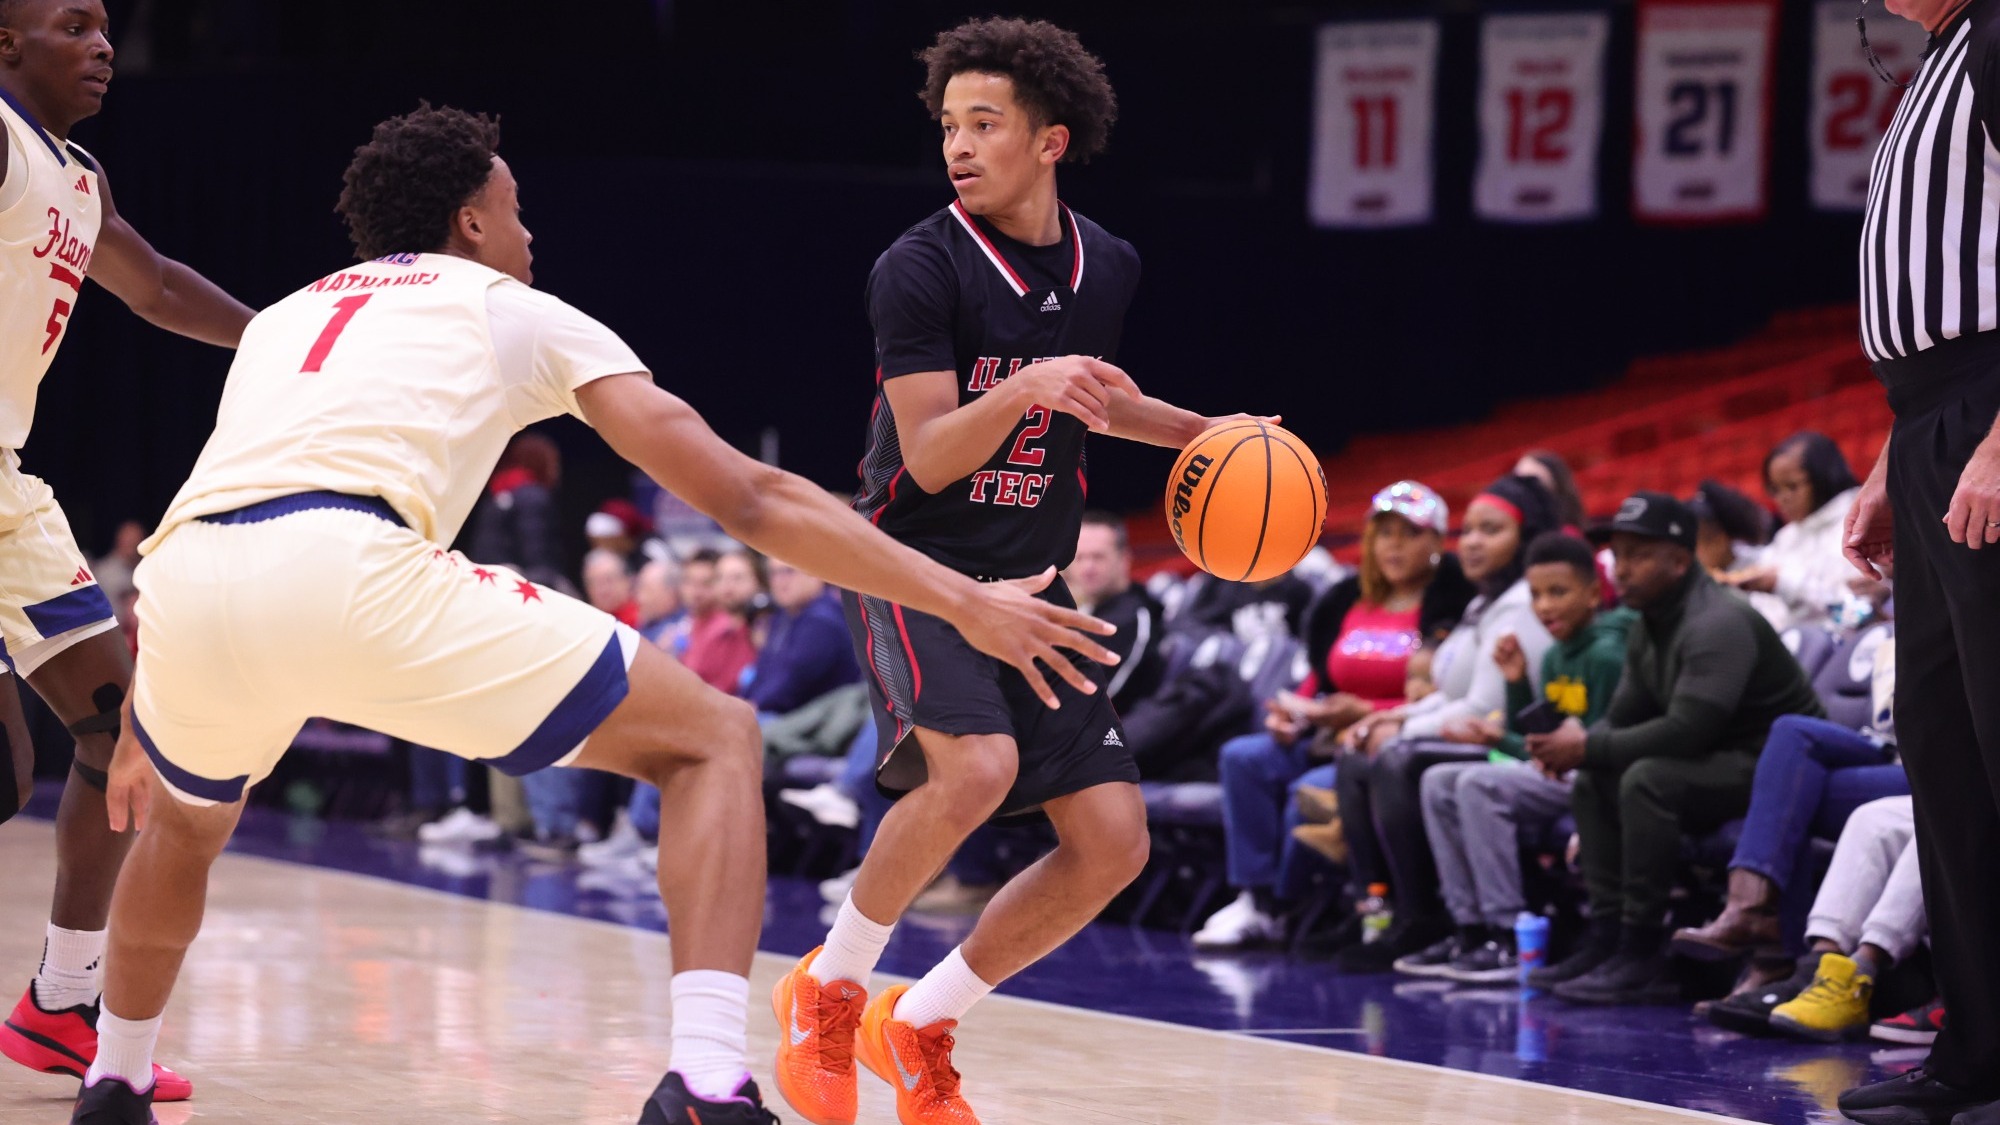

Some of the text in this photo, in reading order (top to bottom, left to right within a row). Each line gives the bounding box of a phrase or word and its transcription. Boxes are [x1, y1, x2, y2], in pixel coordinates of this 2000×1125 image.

[1352, 93, 1397, 171] 11
[1505, 86, 1573, 164] 12
[1664, 80, 1736, 157] 21
[33, 206, 91, 275] Flam
[41, 298, 70, 356] 5
[299, 293, 374, 373] 1
[1040, 304, 1062, 312] adidas
[1006, 403, 1052, 467] 2
